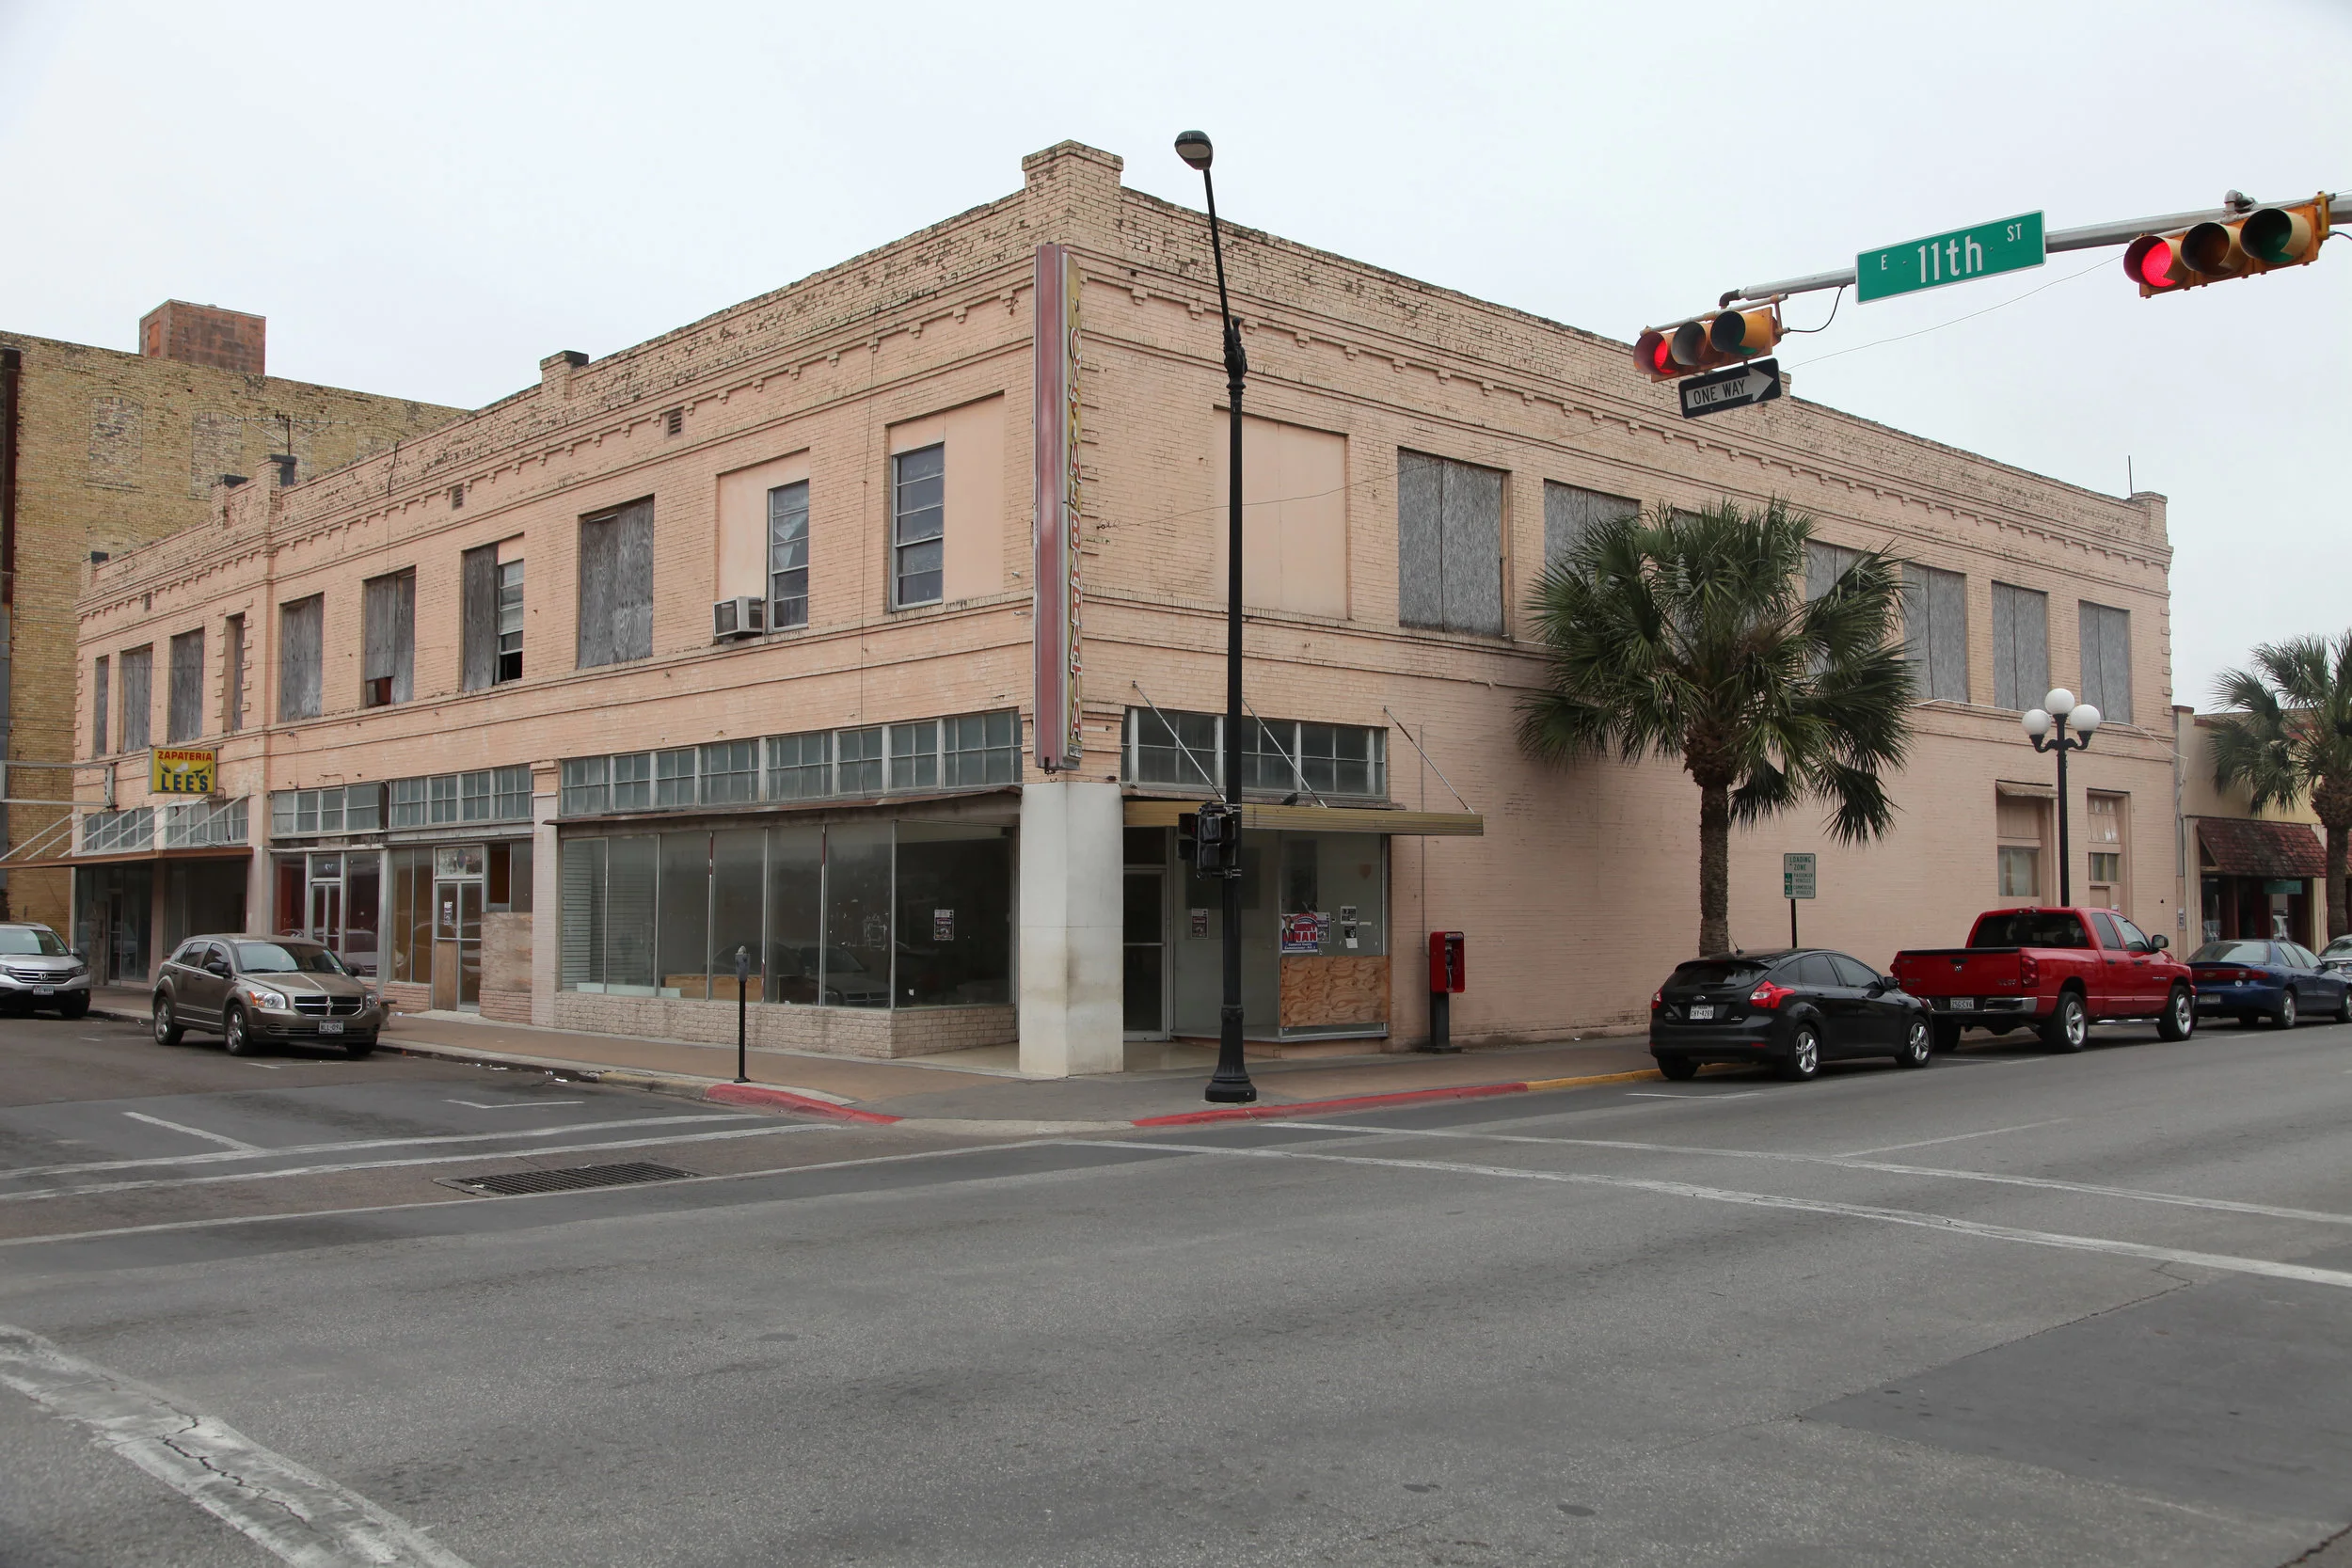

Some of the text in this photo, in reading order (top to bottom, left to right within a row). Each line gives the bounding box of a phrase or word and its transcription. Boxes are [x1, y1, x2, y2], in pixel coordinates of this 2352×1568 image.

[1882, 223, 2022, 283] E 11th ST
[1693, 379, 1745, 404] ONE WAY
[1069, 507, 1083, 742] BARATA
[158, 751, 213, 761] ZAPATERIA
[161, 773, 208, 791] LEE'S
